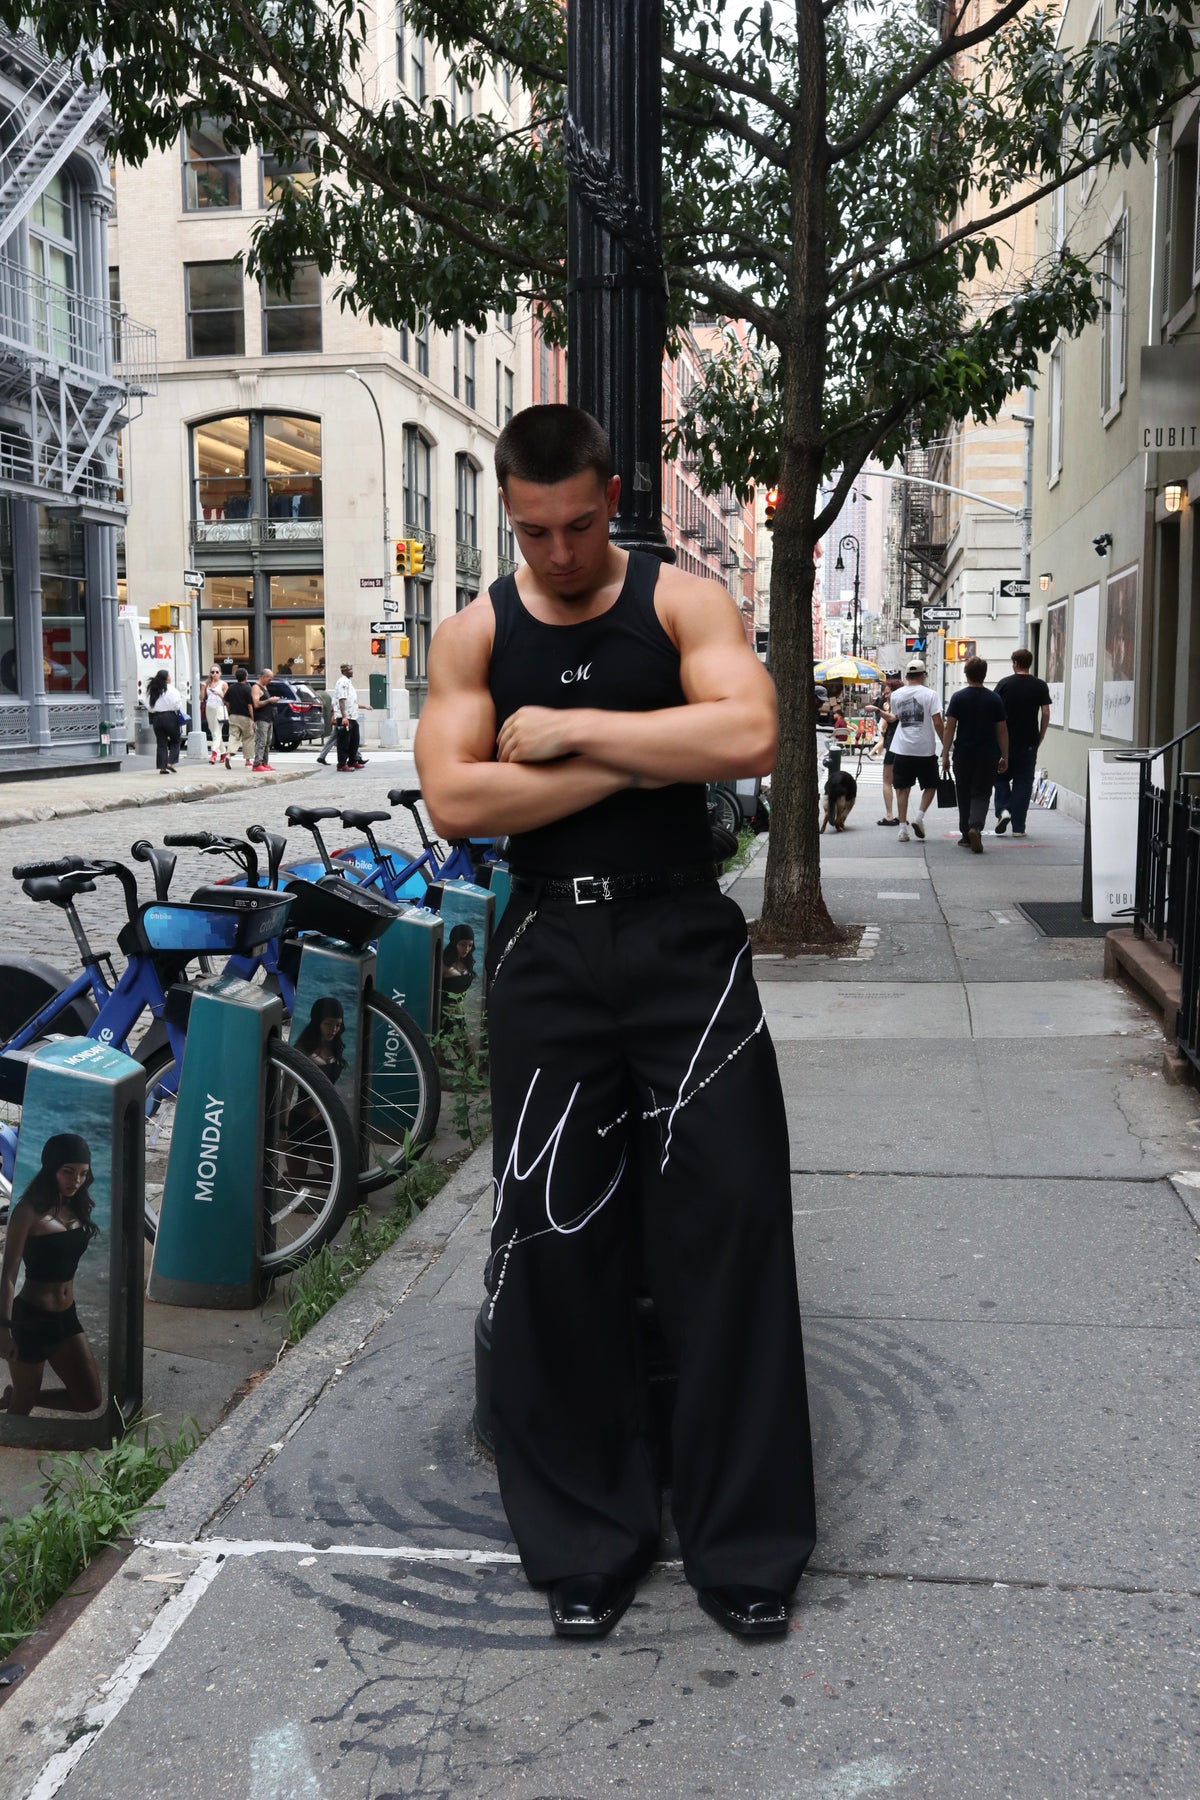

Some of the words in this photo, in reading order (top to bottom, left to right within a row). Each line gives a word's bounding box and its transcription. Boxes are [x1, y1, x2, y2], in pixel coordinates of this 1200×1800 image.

[1008, 585, 1024, 593] ONE
[140, 634, 172, 660] edEx
[223, 656, 234, 664] alo
[293, 655, 304, 664] alo
[383, 988, 406, 1068] MONY
[63, 1044, 108, 1066] MONDAY
[194, 1093, 225, 1202] MONDAY
